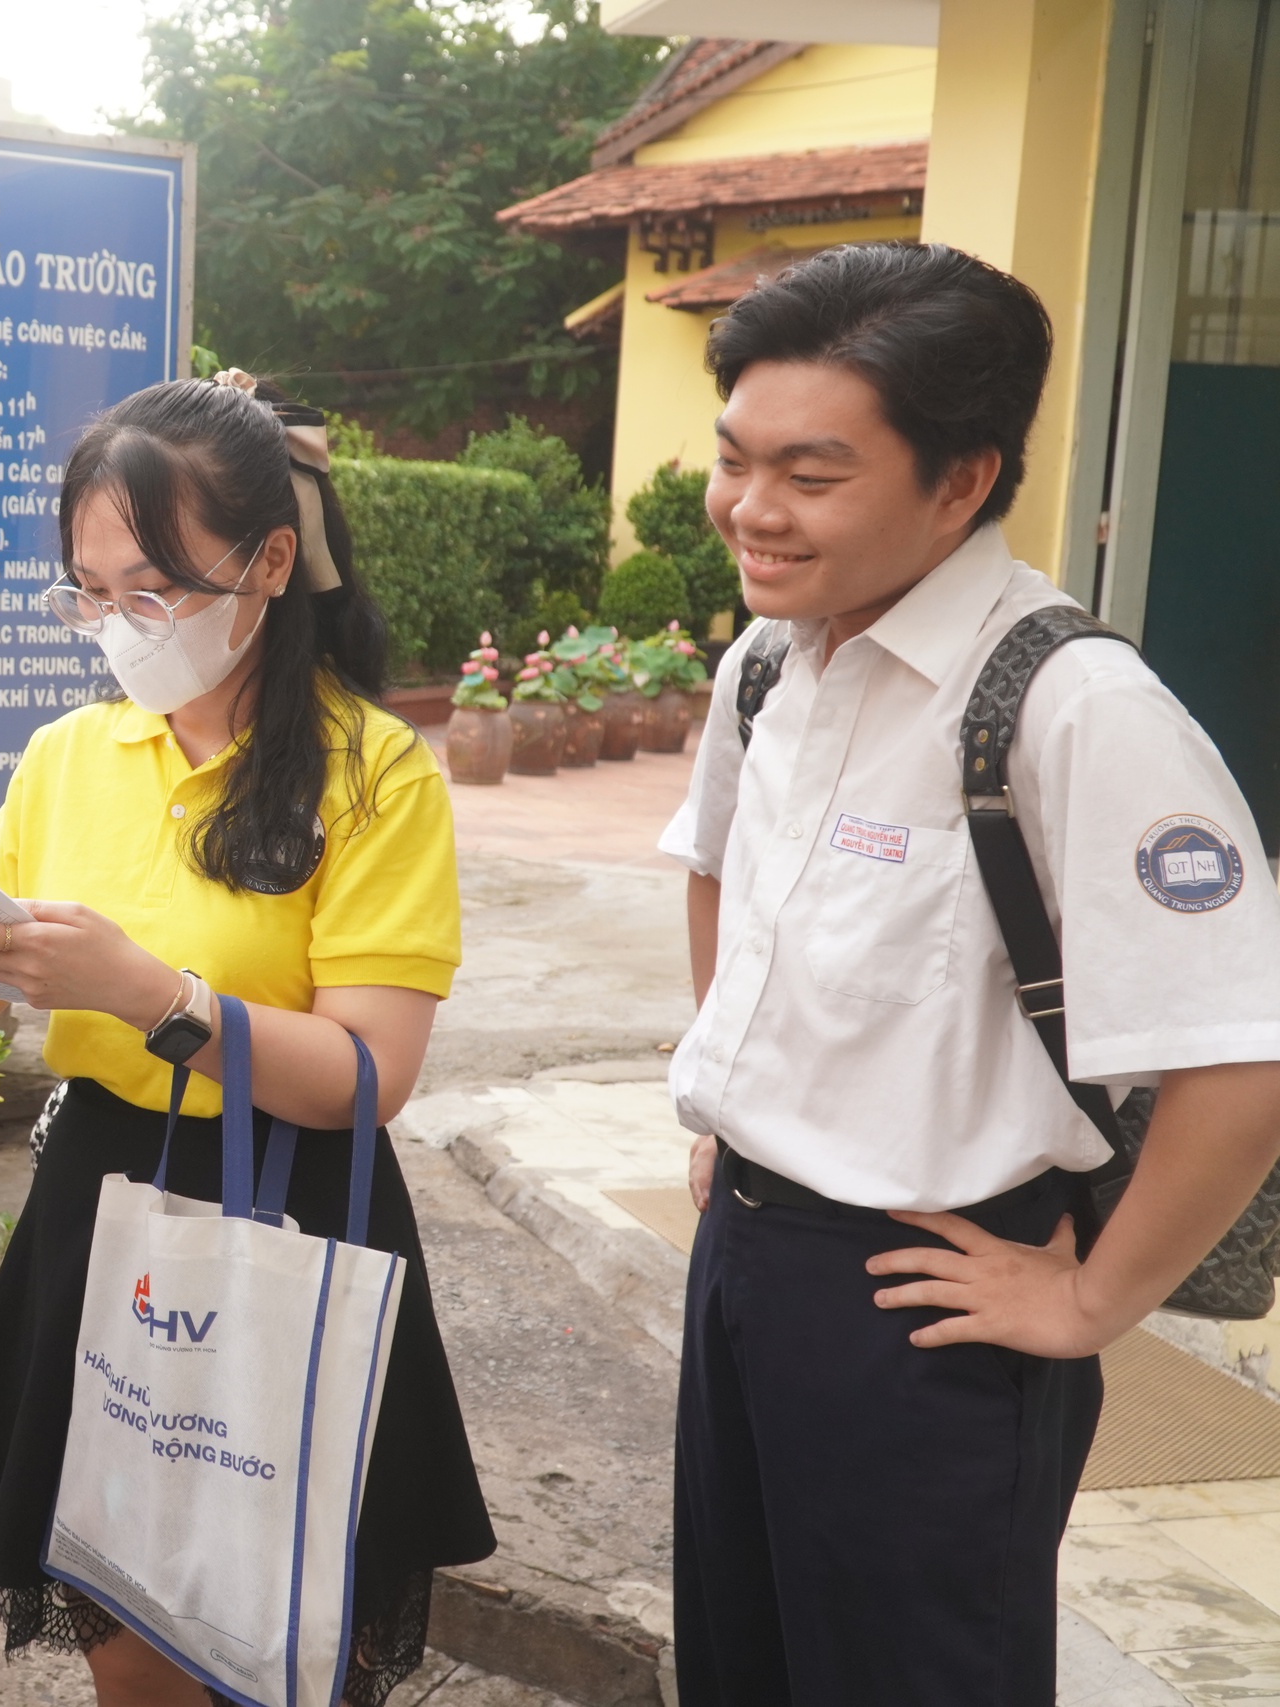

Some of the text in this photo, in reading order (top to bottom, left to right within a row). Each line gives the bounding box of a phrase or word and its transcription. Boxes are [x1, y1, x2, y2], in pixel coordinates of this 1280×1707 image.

[35, 248, 157, 299] TRƯỜNG
[17, 318, 64, 345] CÔNG
[68, 323, 106, 352] VIỆC
[109, 323, 147, 351] CẦN:
[8, 391, 36, 417] 11h
[18, 424, 45, 451] 17h
[8, 458, 42, 483] CÁC
[2, 488, 47, 518] (GIẤY
[4, 556, 50, 580] NHÂN
[16, 625, 71, 644] TRONG
[19, 656, 85, 678] CHUNG,
[34, 683, 58, 707] VÀ
[62, 680, 98, 706] CHẤ
[1167, 861, 1187, 875] QT
[1197, 860, 1216, 872] NH
[1143, 877, 1169, 904] QUANG
[1171, 899, 1202, 911] TRUNG
[150, 1410, 228, 1439] VƯƠNG
[152, 1437, 216, 1463] RỘNG
[220, 1450, 276, 1480] BƯỚC
